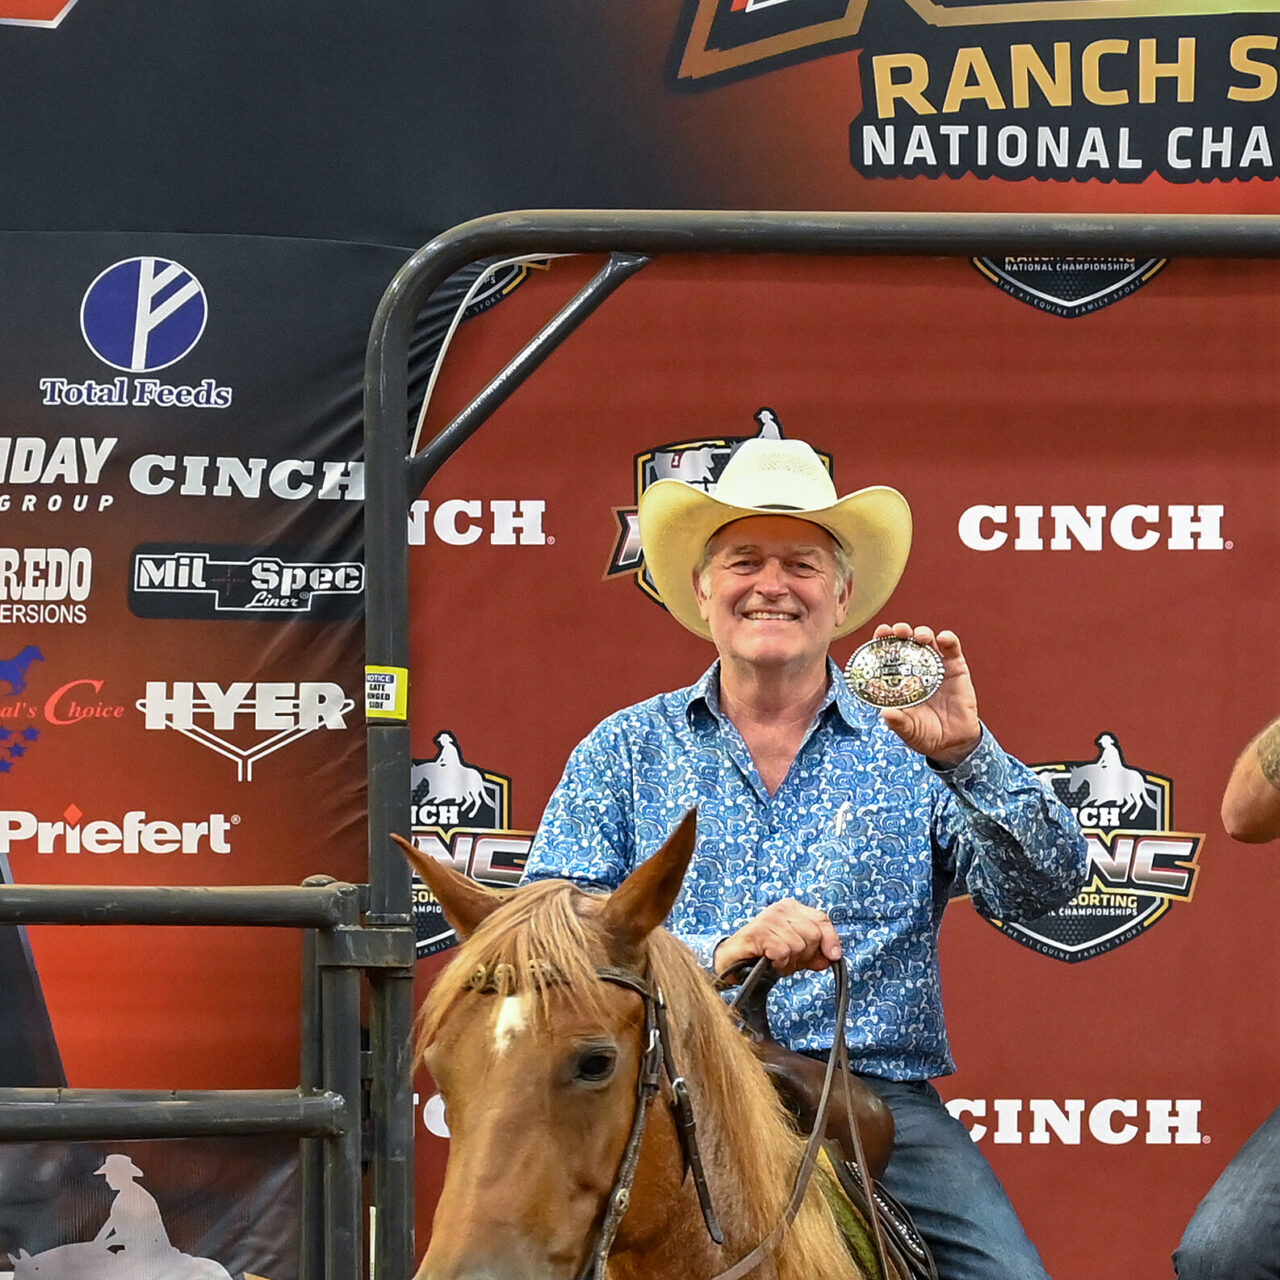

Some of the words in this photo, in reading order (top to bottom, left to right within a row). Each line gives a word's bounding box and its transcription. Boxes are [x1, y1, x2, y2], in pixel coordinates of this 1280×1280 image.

[872, 47, 1196, 119] RANCH
[862, 124, 1142, 170] NATIONAL
[1004, 263, 1053, 272] NATIONAL
[1056, 263, 1136, 272] CHAMPIONSHIPS
[40, 377, 128, 405] Total
[133, 379, 232, 408] Feeds
[130, 454, 366, 501] CINCH
[958, 504, 1224, 551] CINCH
[139, 558, 206, 588] Mil
[251, 562, 360, 595] Spec
[246, 593, 299, 609] Liner
[44, 679, 125, 725] Choice
[144, 681, 348, 730] HYER
[0, 804, 231, 854] Priefert
[1058, 907, 1138, 916] CHAMPIONSHIPS
